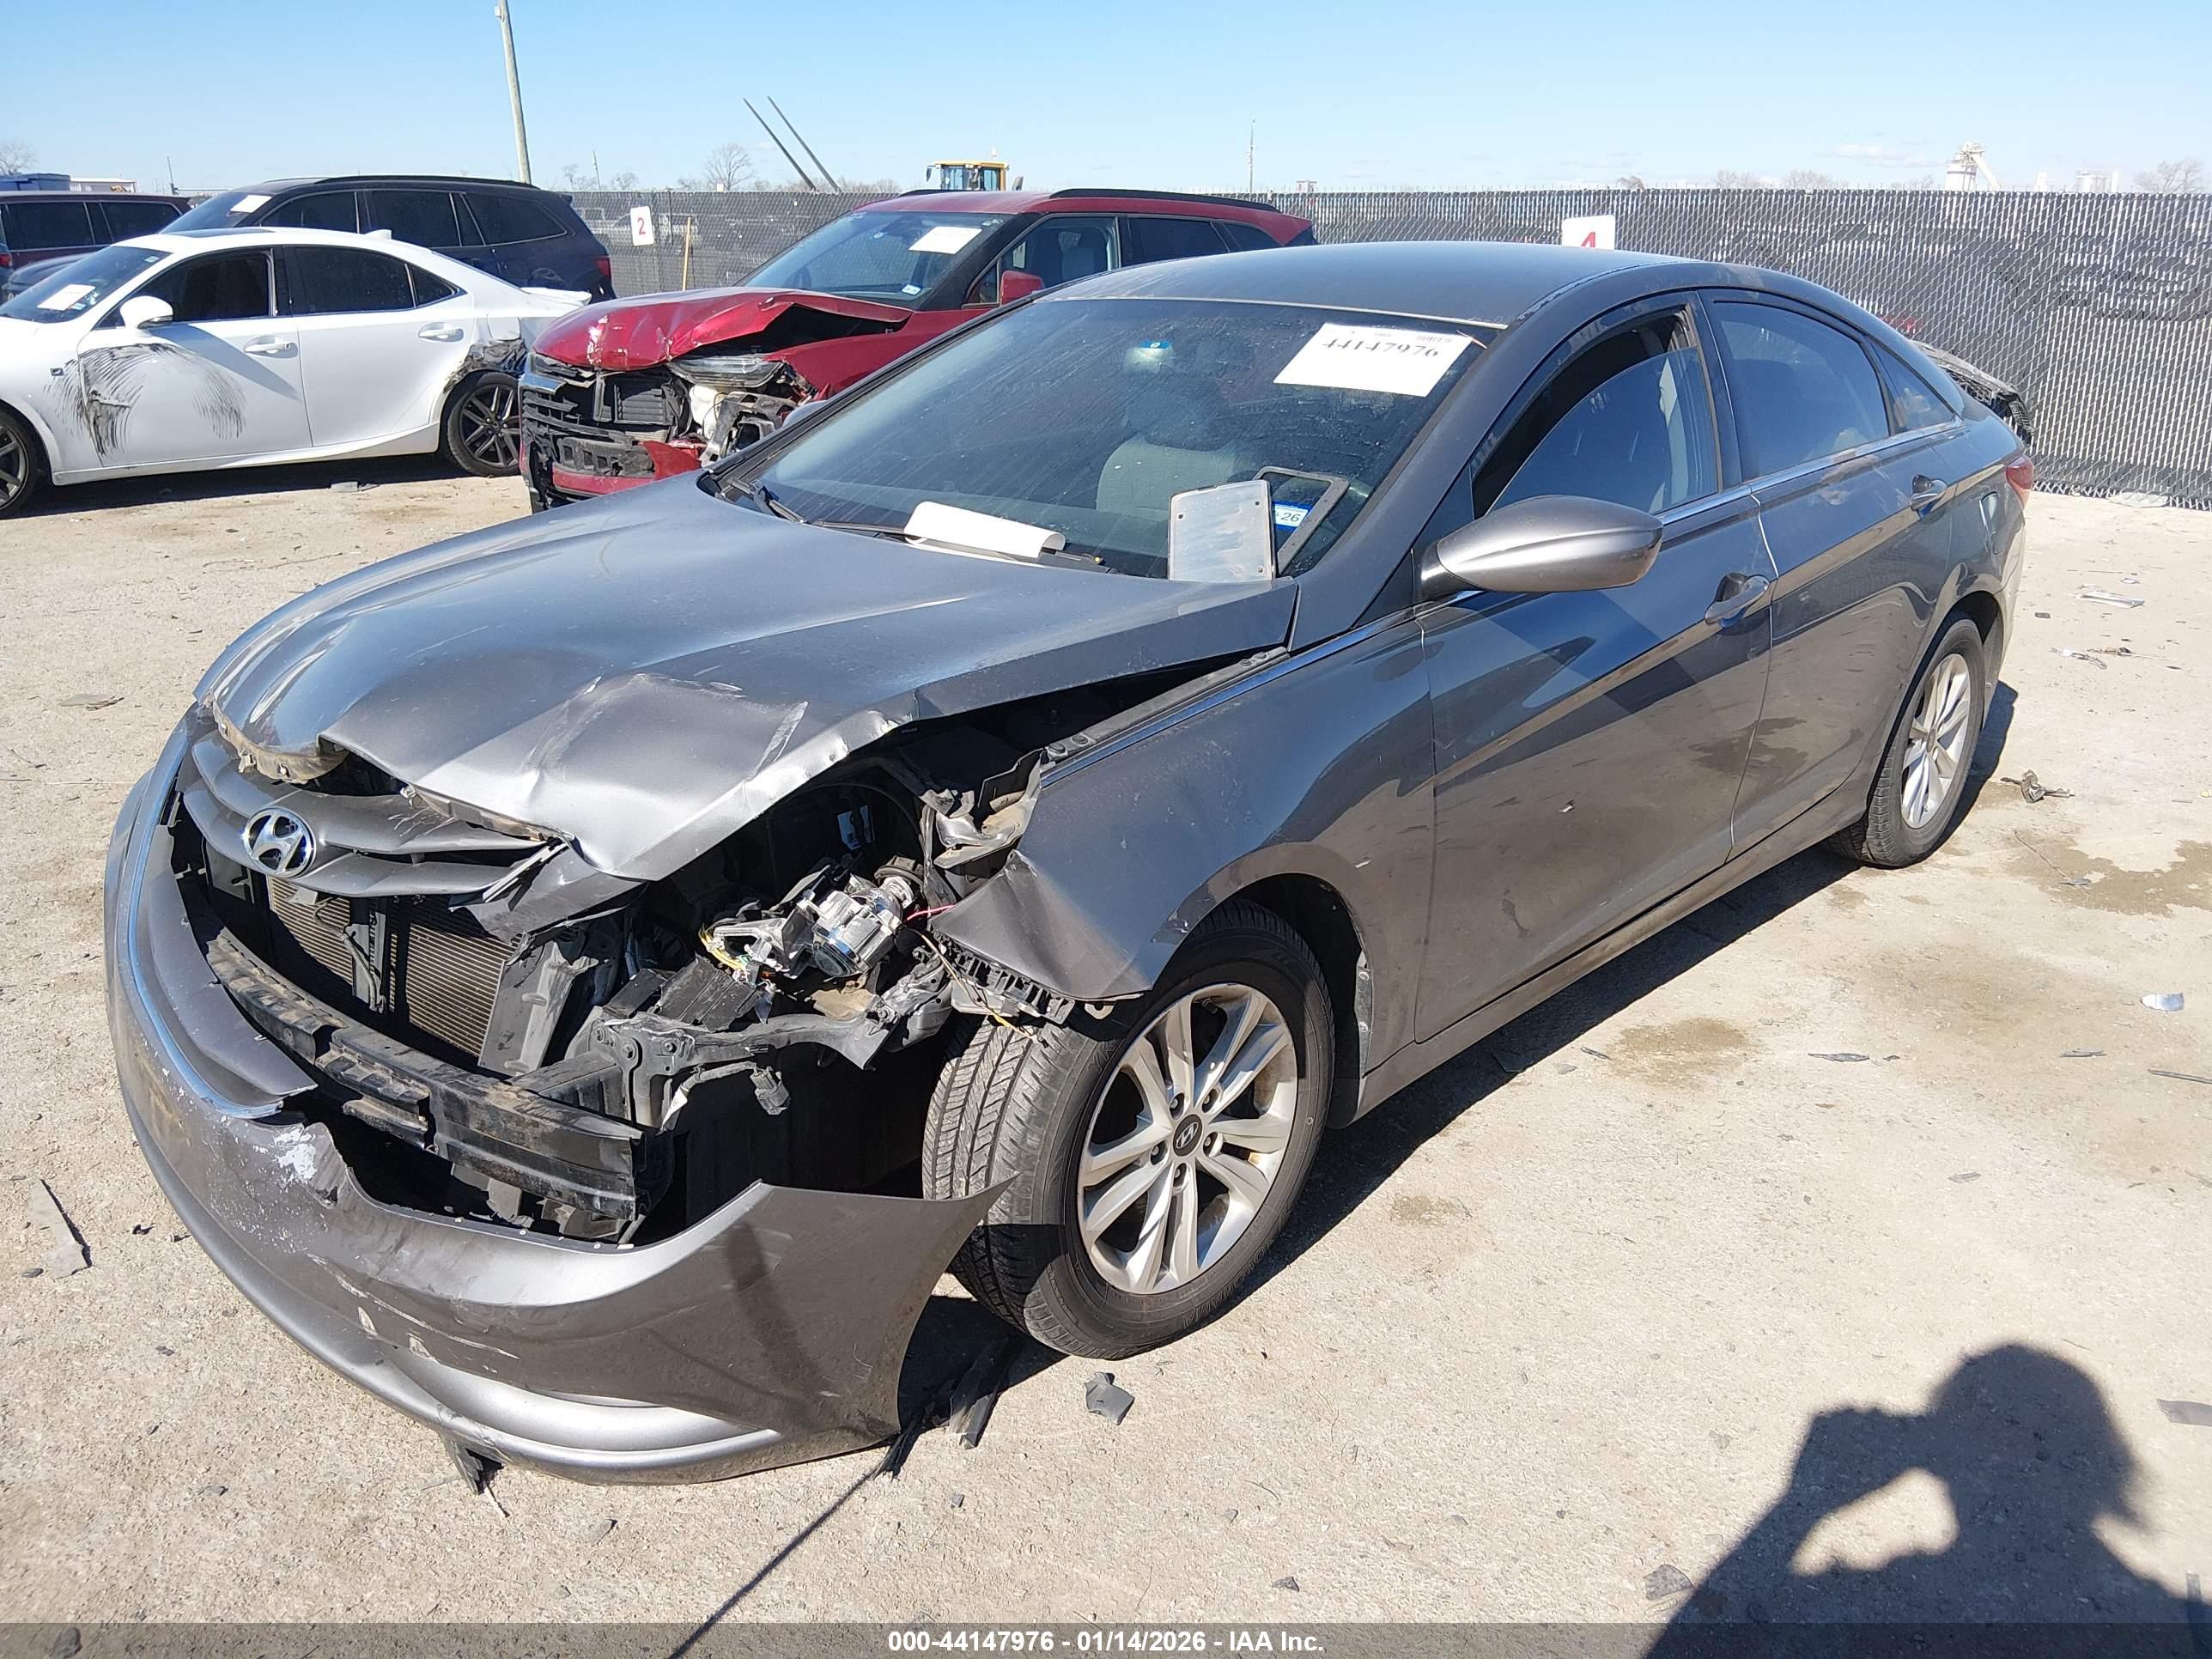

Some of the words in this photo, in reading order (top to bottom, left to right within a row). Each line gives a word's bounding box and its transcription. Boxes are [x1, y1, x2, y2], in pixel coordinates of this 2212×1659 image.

[637, 217, 646, 235] 2
[1322, 338, 1439, 357] 44147976
[1280, 512, 1302, 522] 26
